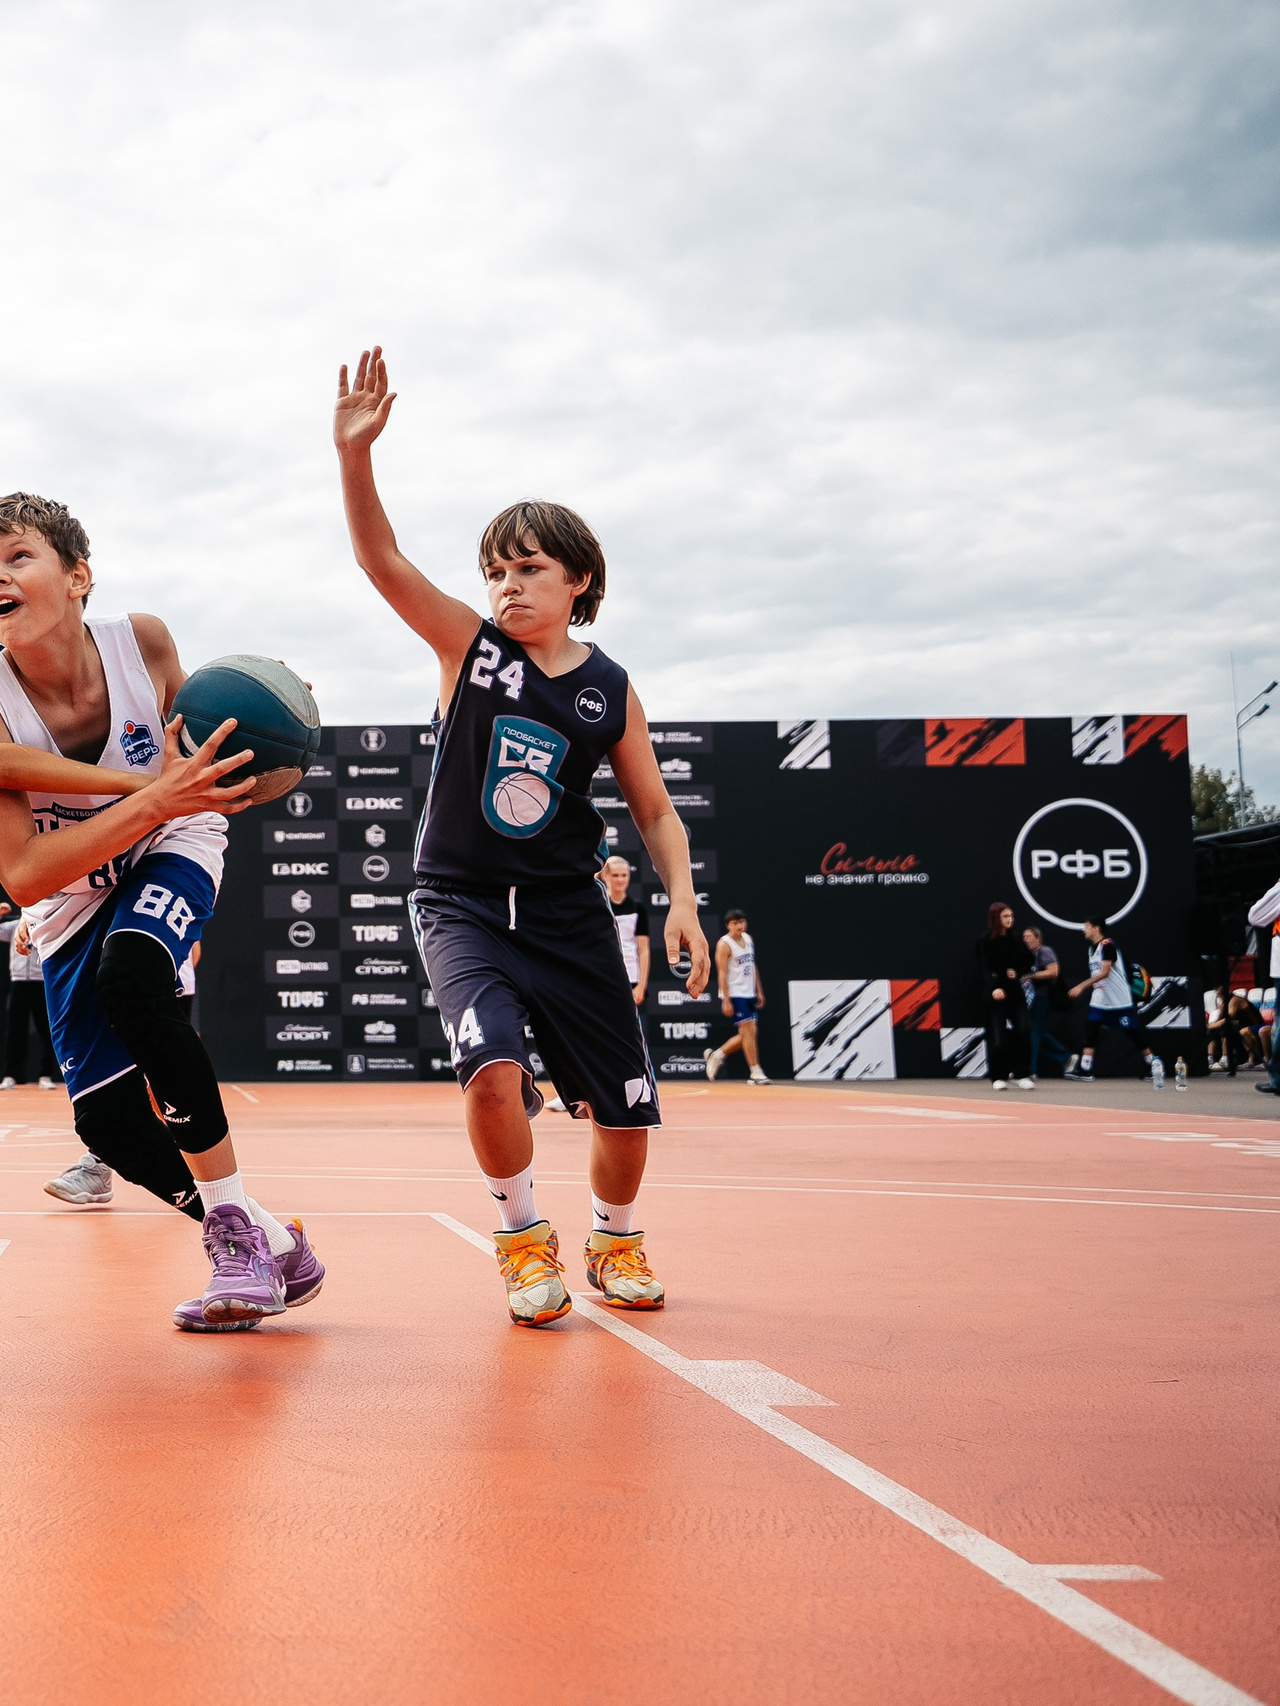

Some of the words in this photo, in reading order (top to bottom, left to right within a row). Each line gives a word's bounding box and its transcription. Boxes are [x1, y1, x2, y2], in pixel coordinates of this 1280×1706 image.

[470, 638, 525, 700] 24
[579, 697, 604, 713] РФБ
[503, 726, 558, 751] ПРОБАСКЕТ
[126, 744, 159, 764] ТВЕРЬ
[365, 797, 403, 810] DKC
[820, 842, 921, 875] Сильно
[1030, 848, 1133, 880] РФБ
[291, 862, 330, 876] DKC
[805, 874, 825, 886] не
[826, 873, 875, 886] значит
[877, 872, 930, 887] громко
[132, 883, 196, 941] 88
[355, 965, 410, 975] СПОРТ
[276, 1031, 332, 1041] СПОРТ
[660, 1062, 707, 1073] СПОР
[163, 1114, 191, 1124] DEMIX
